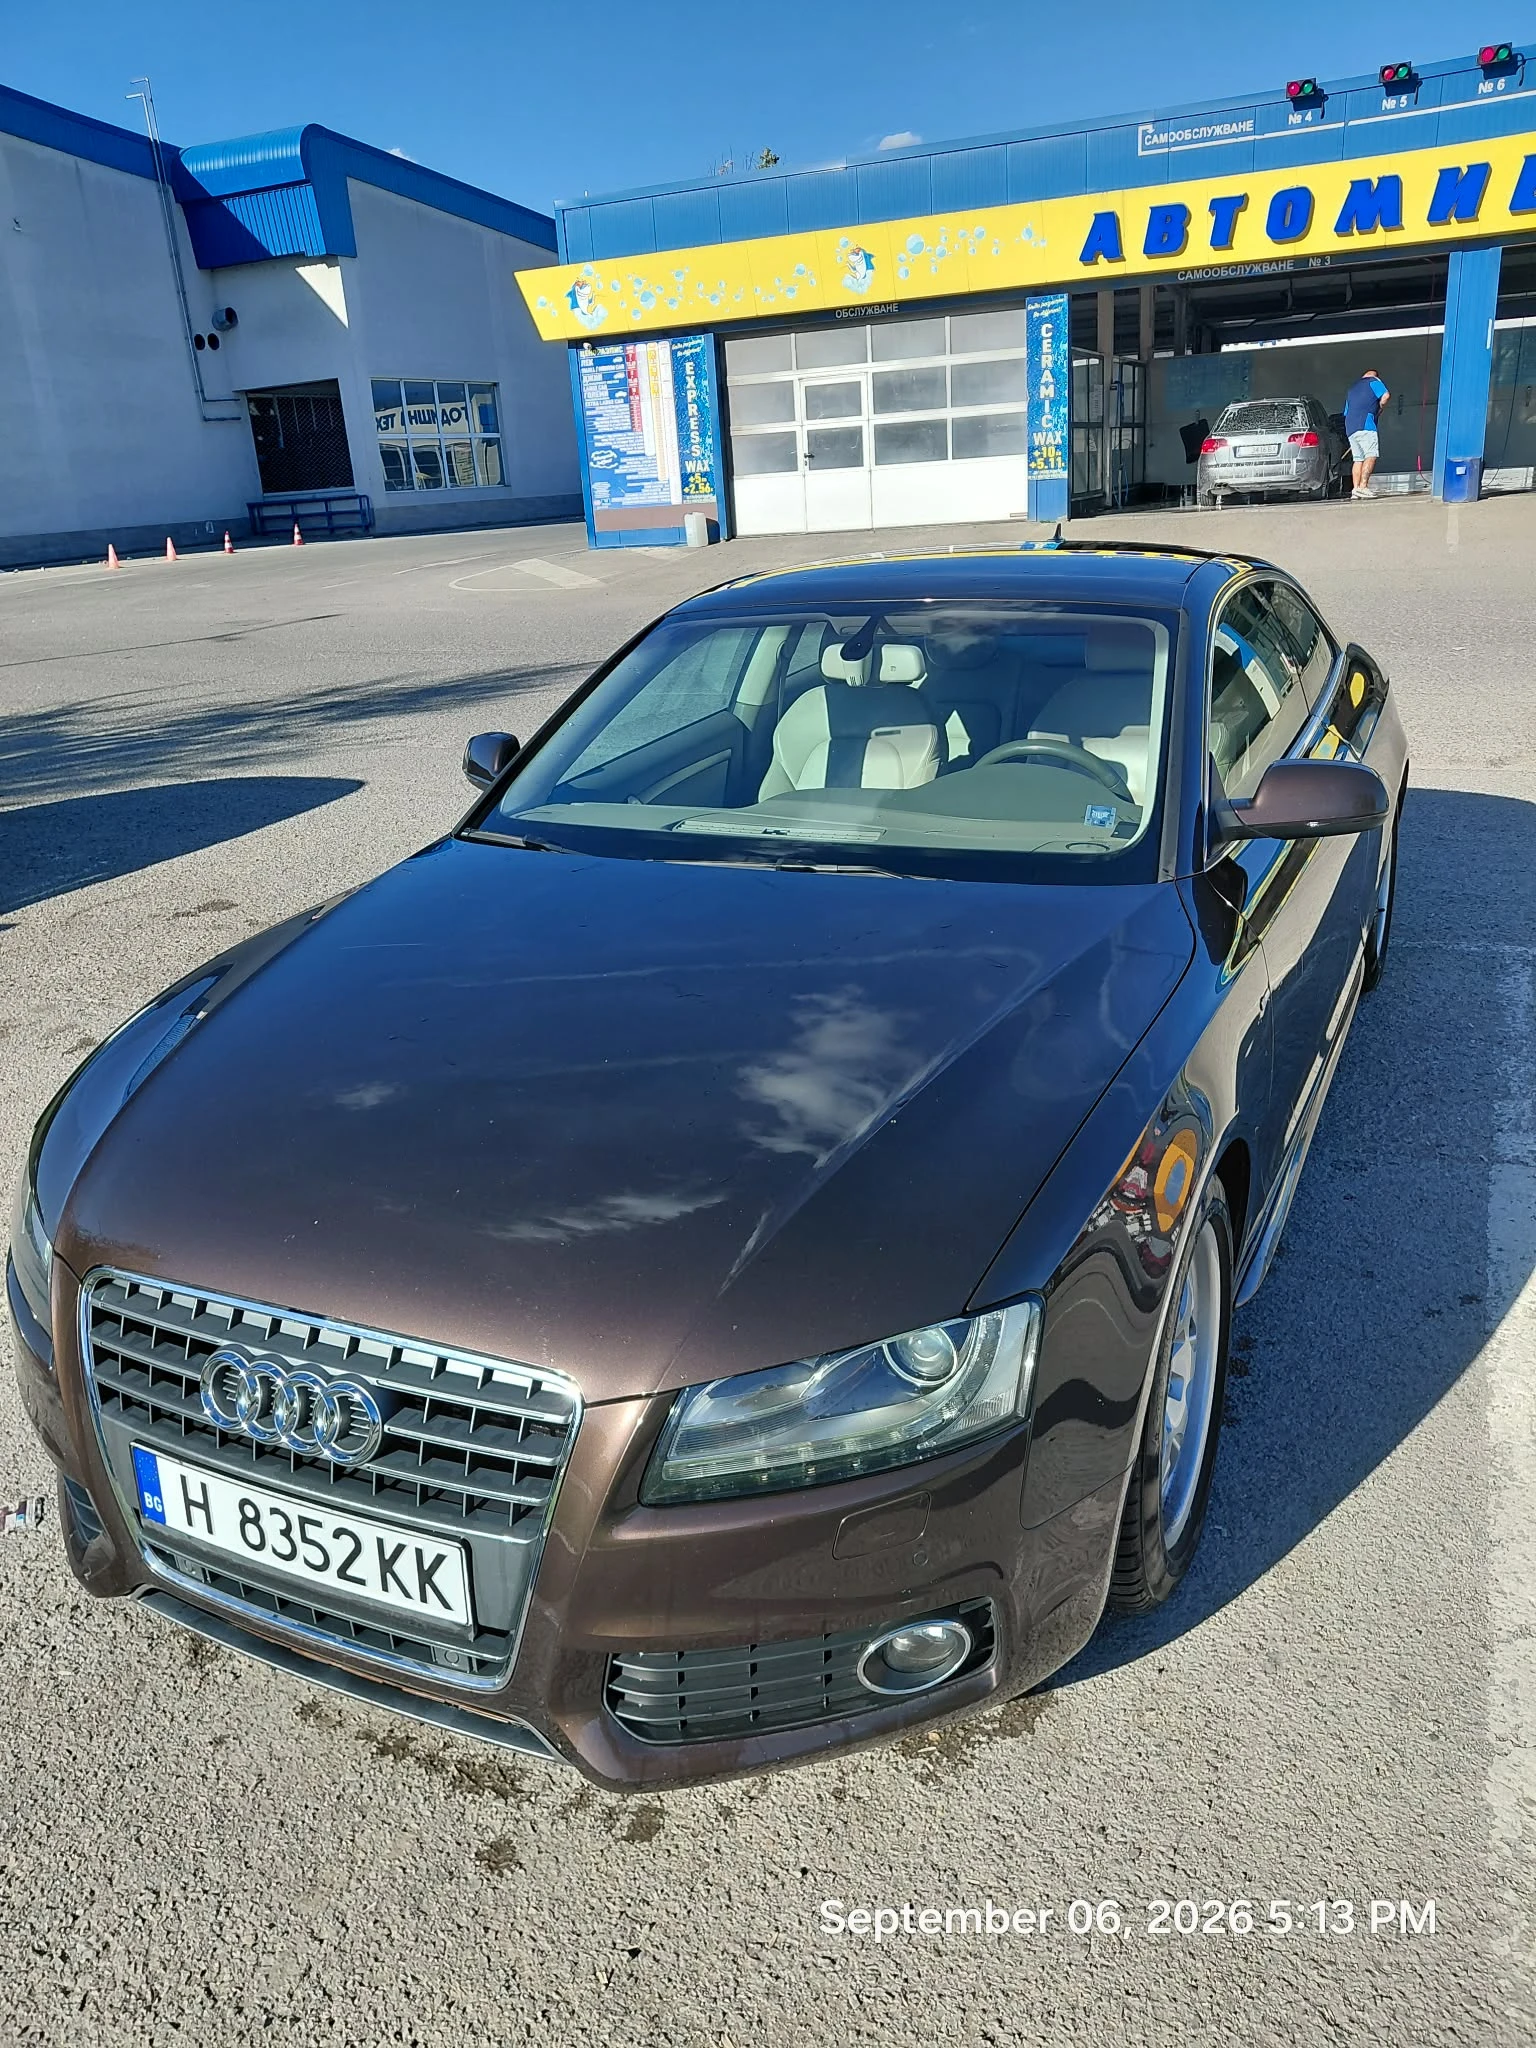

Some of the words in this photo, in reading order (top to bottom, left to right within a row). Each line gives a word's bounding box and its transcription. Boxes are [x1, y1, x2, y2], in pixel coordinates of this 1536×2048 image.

[1497, 79, 1505, 90] 6
[1400, 96, 1407, 107] 5
[1304, 110, 1312, 122] 4
[1144, 119, 1254, 147] САМООБСЛУЖВАНЕ
[1177, 259, 1294, 281] САМООБСЛУЖВАНЕ
[1323, 255, 1331, 266] 3
[835, 303, 899, 319] ОБСЛУЖВАНЕ
[1040, 323, 1055, 429] CERAMIC
[685, 361, 700, 456] EXPRESS
[1033, 430, 1063, 446] WAX
[684, 460, 711, 473] WAX
[144, 1492, 163, 1511] BG
[180, 1474, 214, 1535] H
